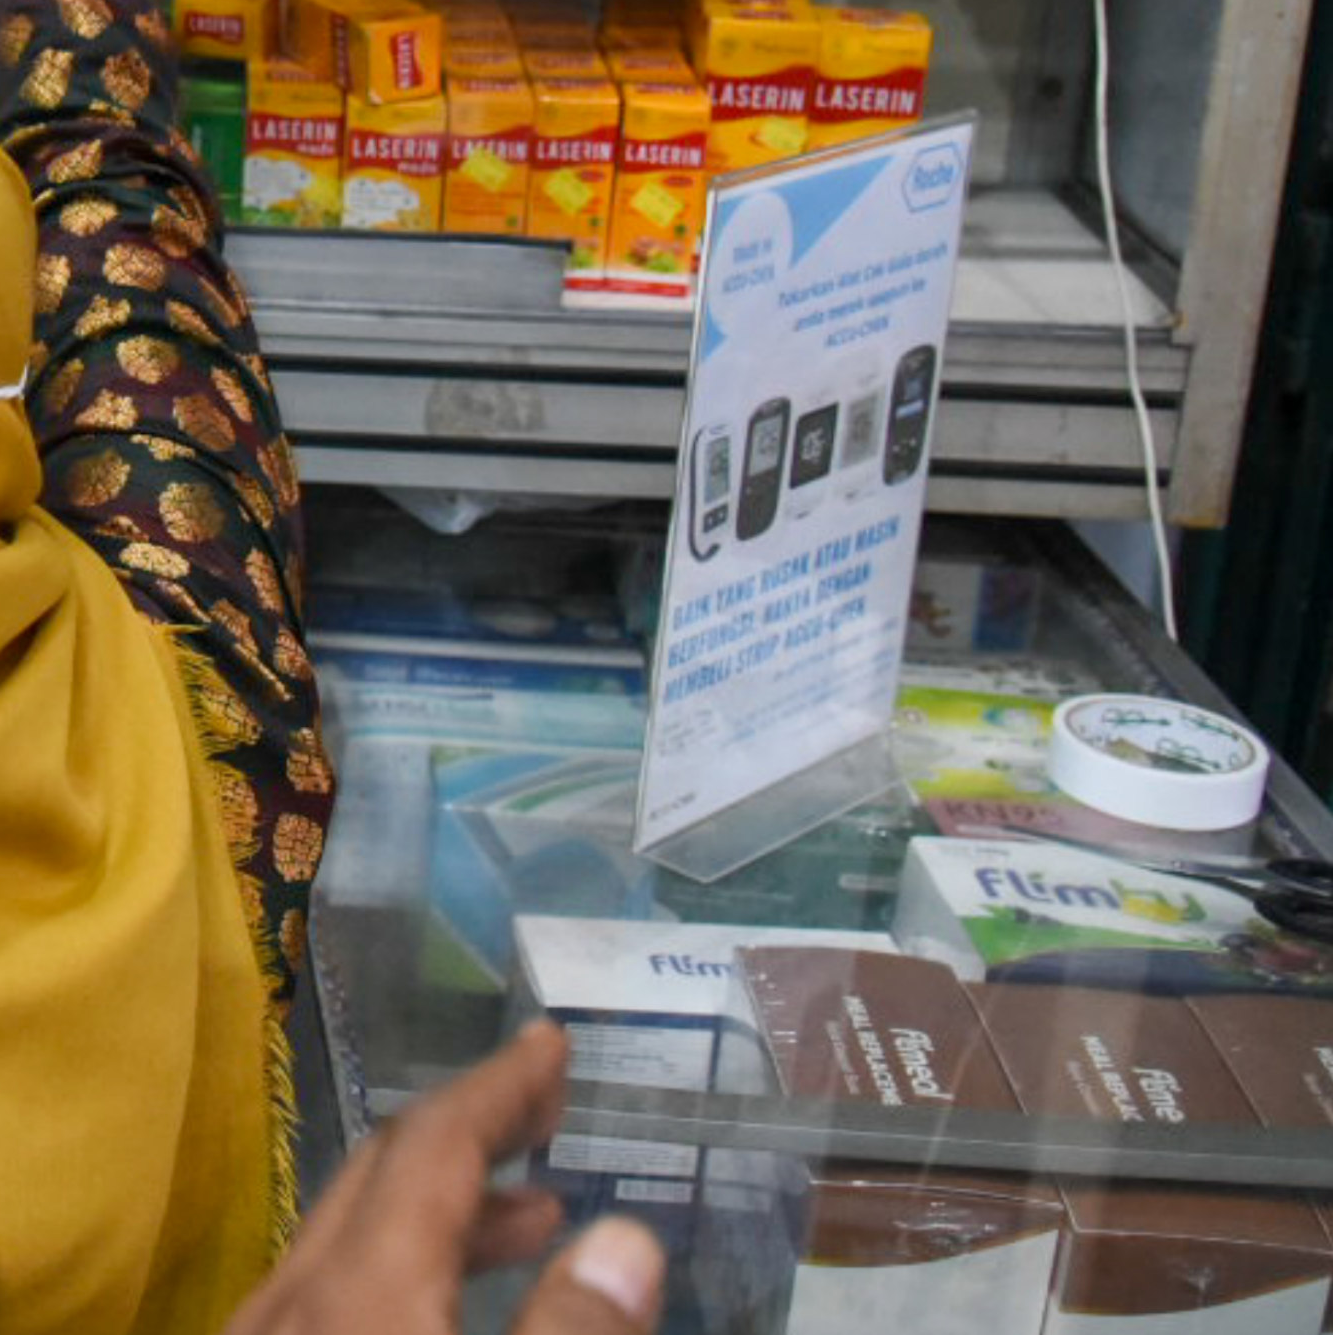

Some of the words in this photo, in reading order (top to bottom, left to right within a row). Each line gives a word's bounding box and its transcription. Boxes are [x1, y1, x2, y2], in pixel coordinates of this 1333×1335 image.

[707, 80, 806, 112] LASERIN
[815, 82, 918, 114] LASERIN
[251, 118, 339, 142] LASERIN
[352, 136, 439, 160] LASERIN
[536, 137, 615, 162] LASERIN
[624, 140, 703, 166] LASERIN
[646, 952, 733, 979] Flim
[855, 1028, 903, 1107] REPLACEME
